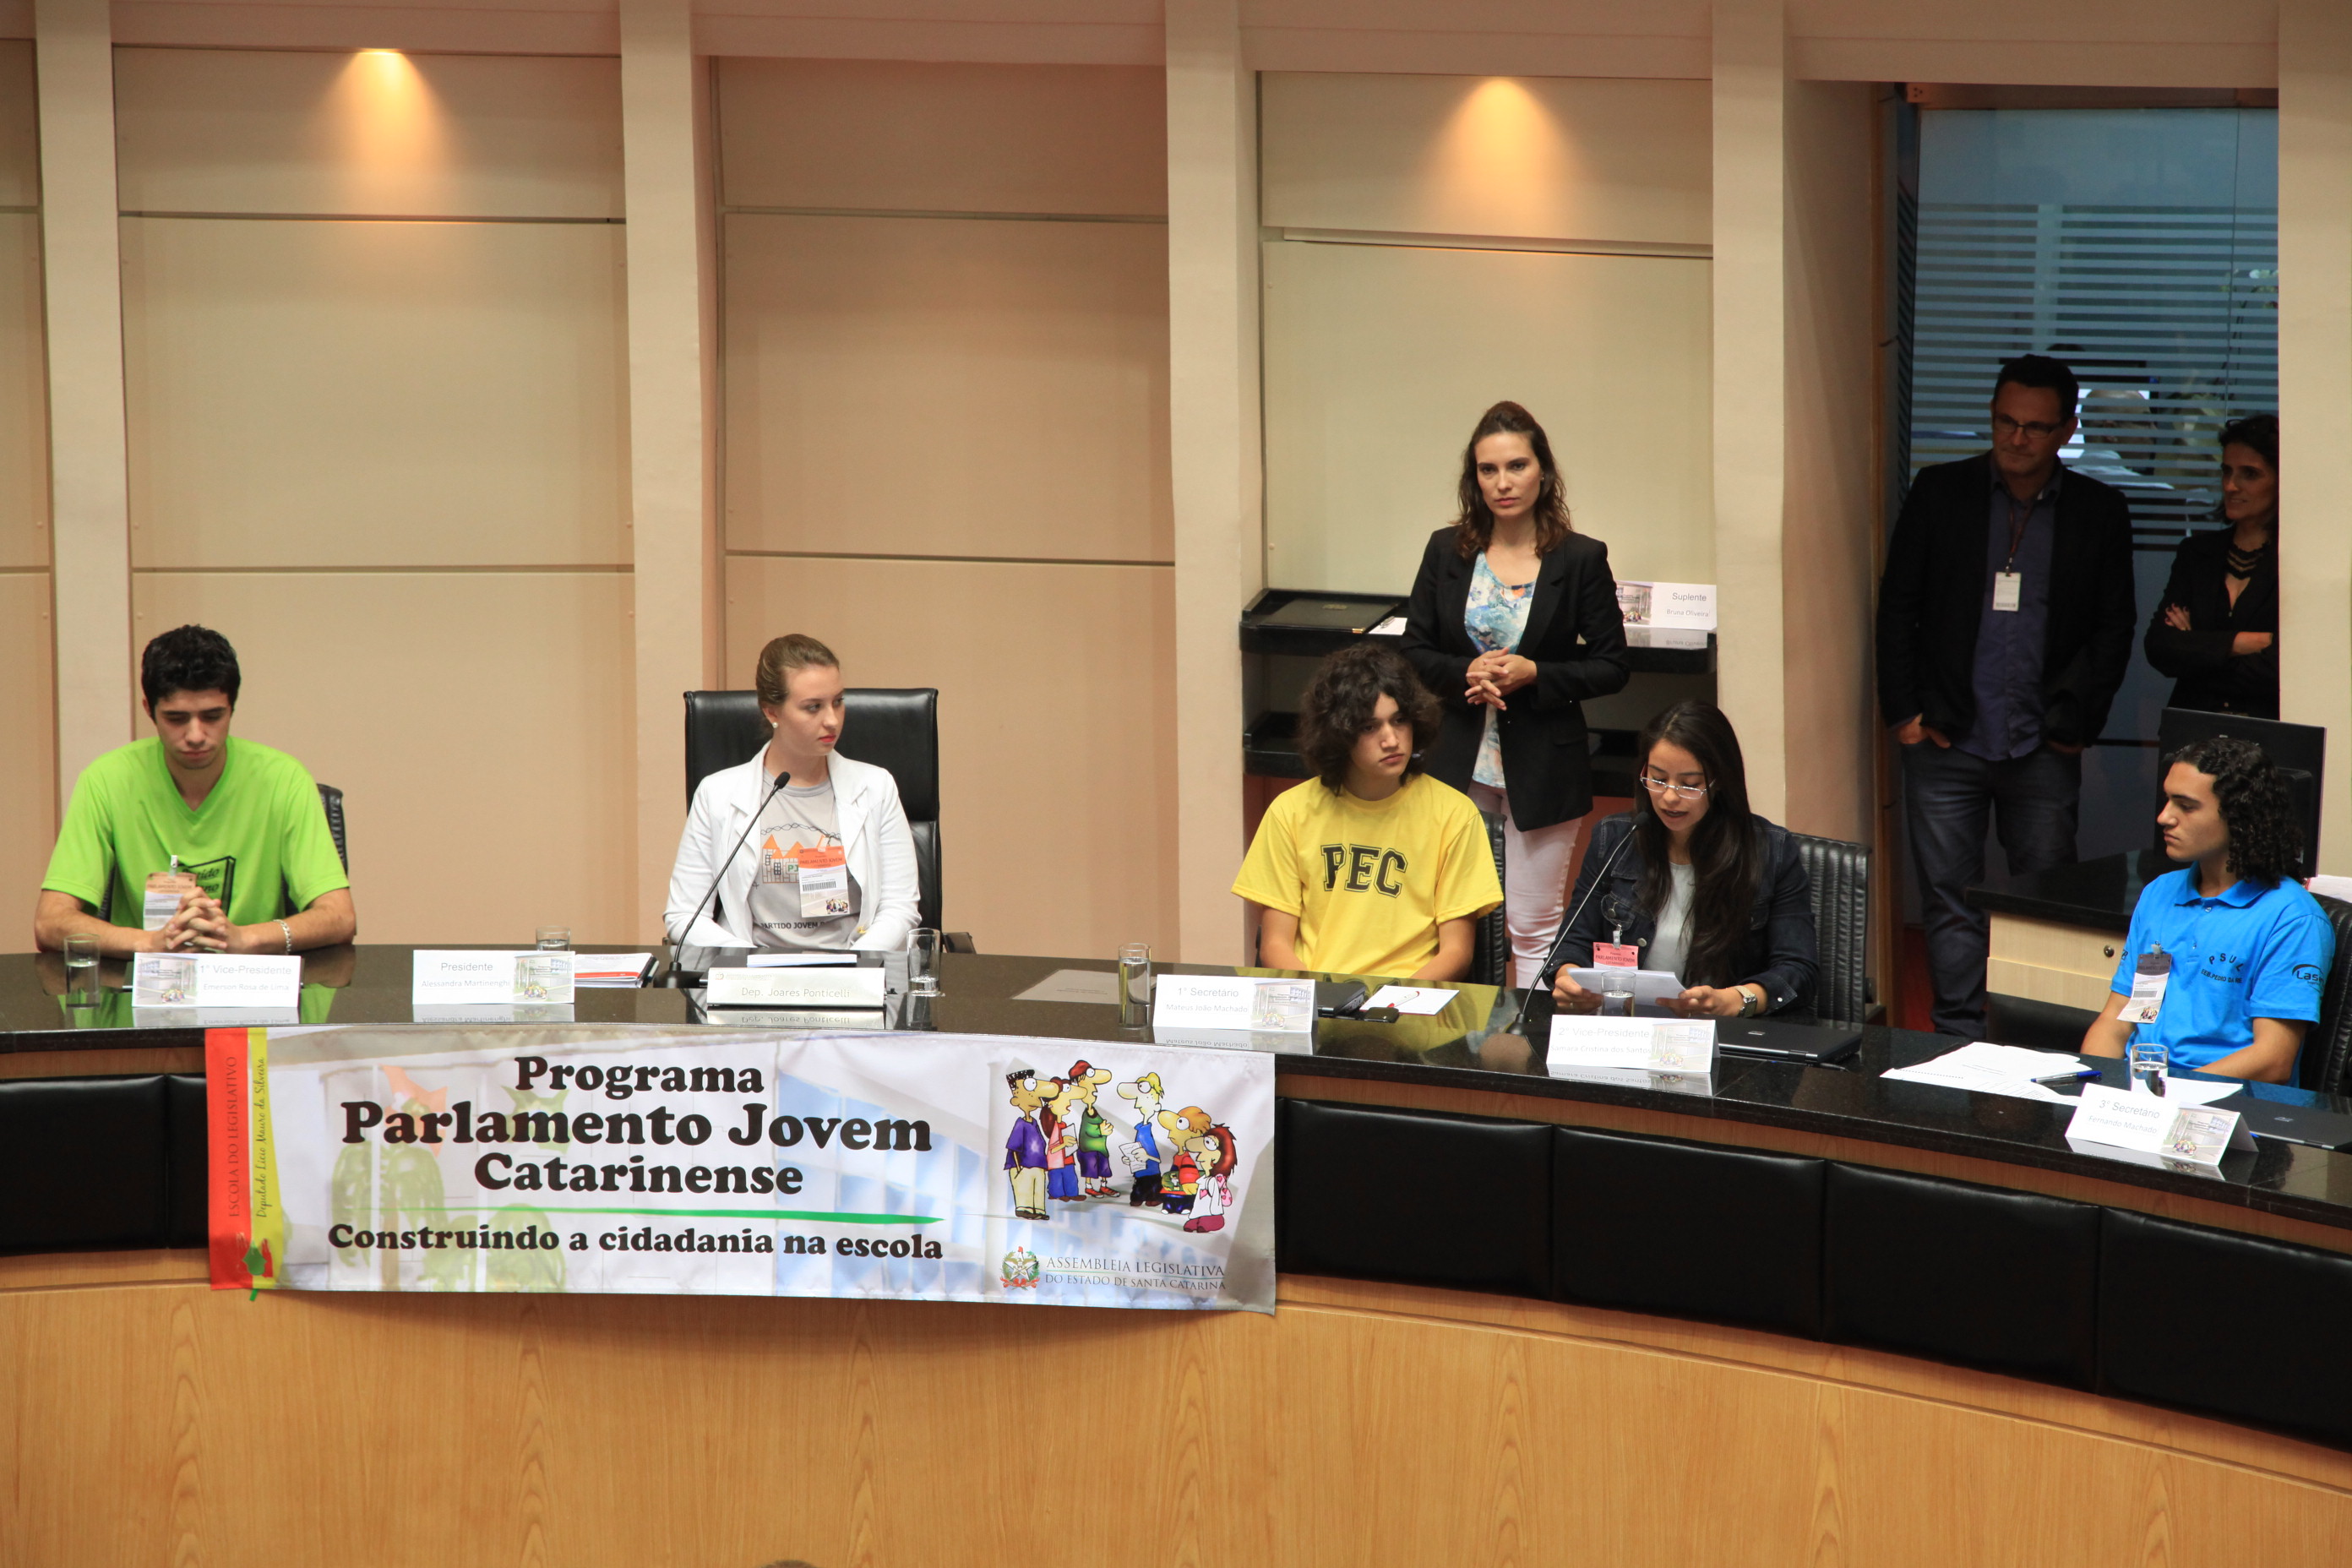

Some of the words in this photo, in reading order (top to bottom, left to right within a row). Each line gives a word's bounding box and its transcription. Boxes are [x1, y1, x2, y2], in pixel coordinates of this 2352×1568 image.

[1672, 592, 1707, 602] Suplente
[1685, 609, 1709, 618] Oliveira
[1320, 843, 1408, 899] PEC
[793, 921, 818, 929] JOVEM
[213, 965, 291, 975] Vice-Presidente
[441, 962, 493, 972] Presidente
[464, 979, 510, 988] Martinenghi
[1190, 987, 1239, 998] Secretário
[742, 988, 764, 998] Dep.
[768, 988, 800, 998] Joares
[803, 988, 850, 999] Ponticelli
[1195, 1004, 1211, 1013] João
[1212, 1004, 1248, 1013] Machado
[1573, 1028, 1650, 1038] Vice-Presidente
[253, 1057, 265, 1096] Silveira
[514, 1056, 765, 1100] Programa
[226, 1056, 238, 1139] LEGISLATIVO
[253, 1098, 265, 1110] da
[2112, 1102, 2160, 1119] Secretário
[255, 1113, 268, 1145] Mauro
[340, 1100, 712, 1146] Parlamento
[727, 1102, 932, 1152] Jovem
[2088, 1115, 2122, 1128] Fernando
[2123, 1121, 2158, 1135] Machado
[227, 1143, 239, 1163] DO
[475, 1152, 803, 1195] Catarinense
[228, 1168, 240, 1217] ESCOLA
[255, 1173, 273, 1217] Deputado
[328, 1223, 559, 1250] Construindo
[569, 1232, 589, 1251] a
[599, 1226, 774, 1255] cidadania
[783, 1233, 827, 1255] na
[836, 1233, 943, 1259] escola
[1046, 1256, 1131, 1272] ASSEMBLEIA
[1135, 1260, 1224, 1277] LEGISLATIVA
[1045, 1274, 1063, 1284] DO
[1066, 1274, 1111, 1286] ESTADO
[1113, 1277, 1128, 1288] DE
[1130, 1277, 1168, 1288] SANTA
[1169, 1278, 1226, 1291] CATARINA
